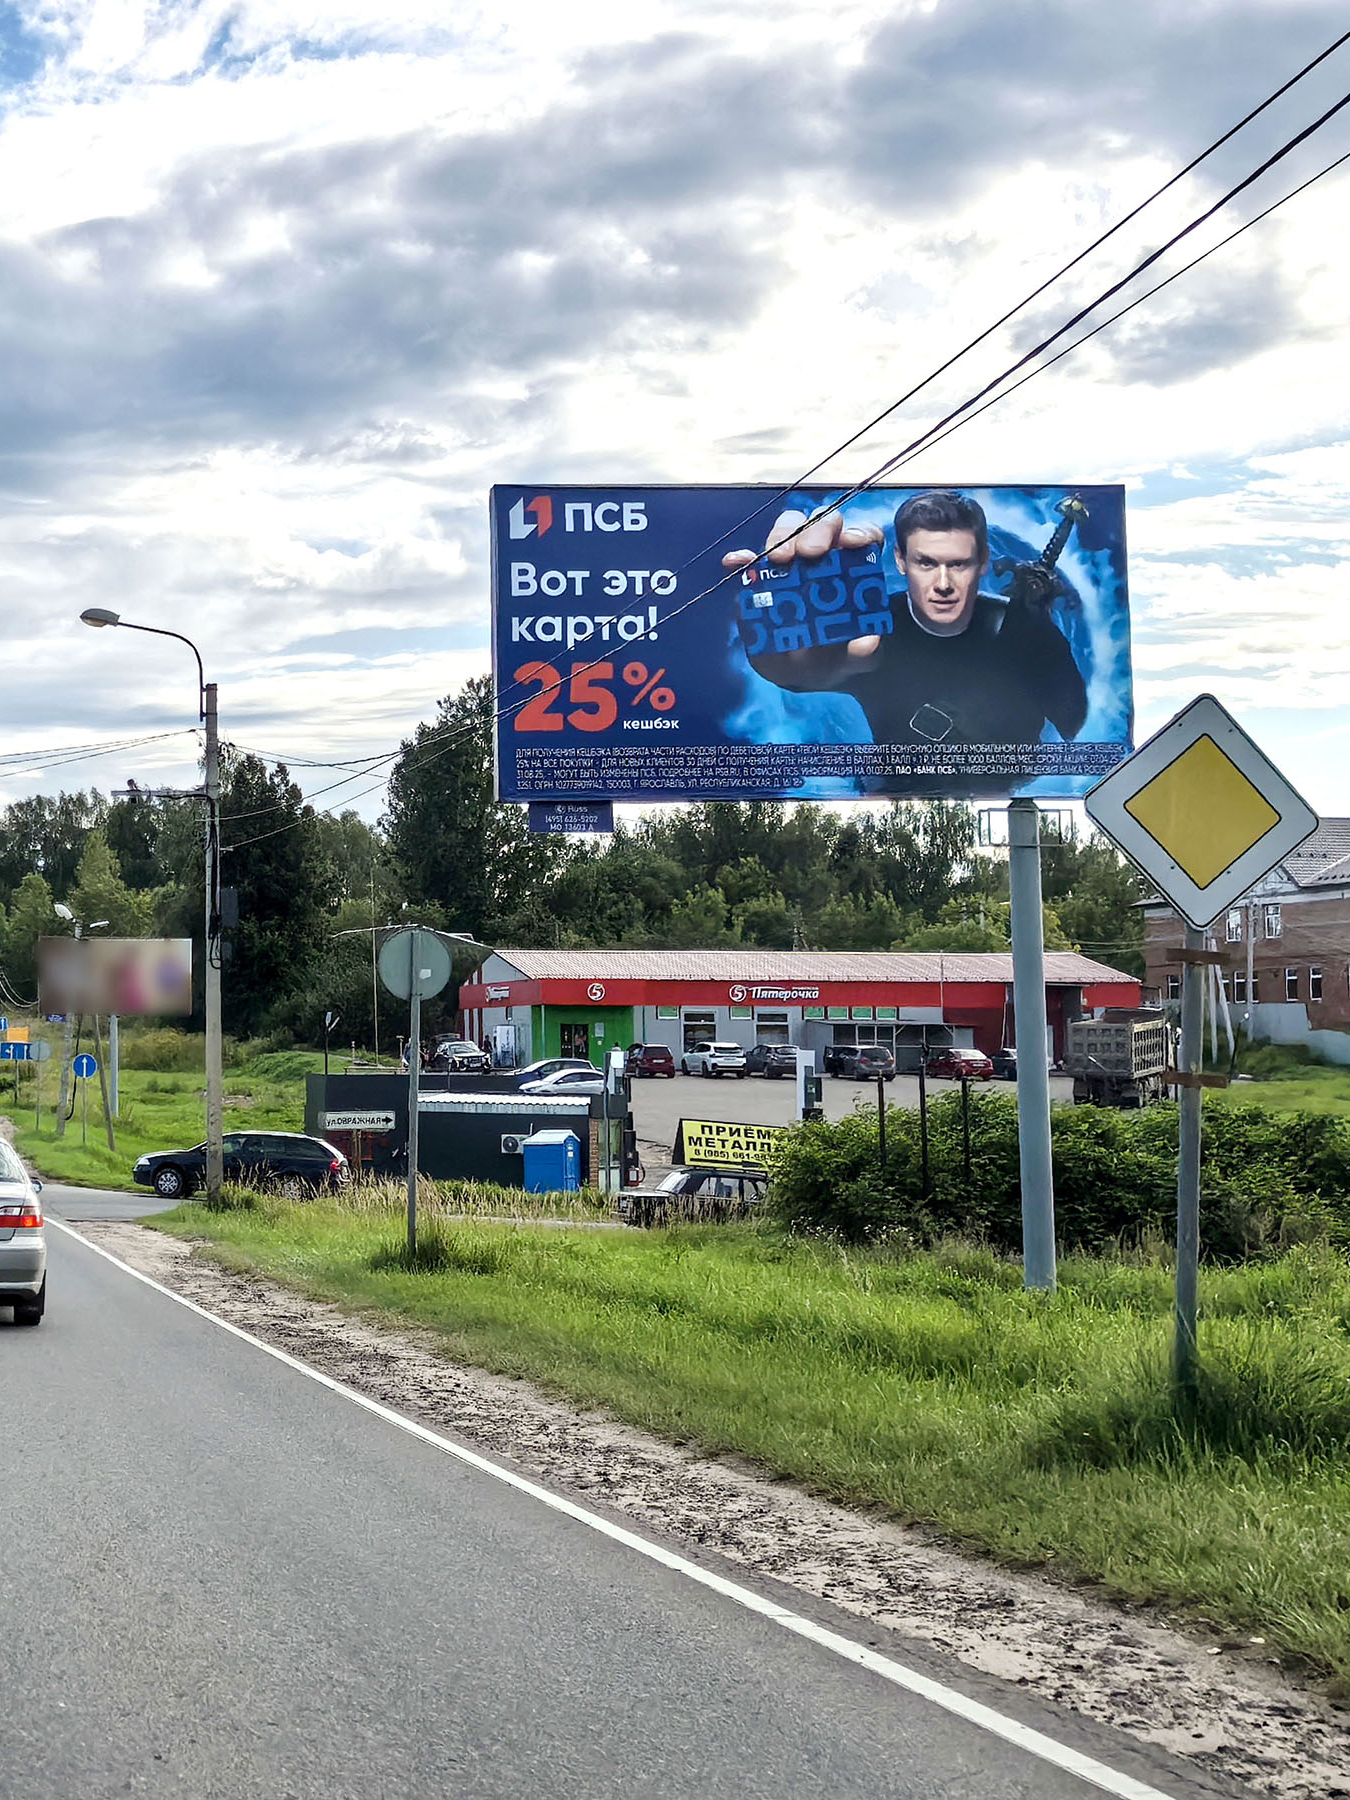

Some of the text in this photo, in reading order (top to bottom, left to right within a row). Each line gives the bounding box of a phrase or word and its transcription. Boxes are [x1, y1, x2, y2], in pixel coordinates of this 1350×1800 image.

[565, 502, 648, 532] ПСБ
[511, 562, 677, 597] Вот это
[511, 606, 659, 651] карта!
[513, 660, 676, 732] 25%
[623, 717, 680, 730] кешбэк
[700, 1124, 771, 1141] ПРИЁМ
[688, 1136, 785, 1154] МЕТАЛЛ
[704, 1149, 730, 1160] (985)
